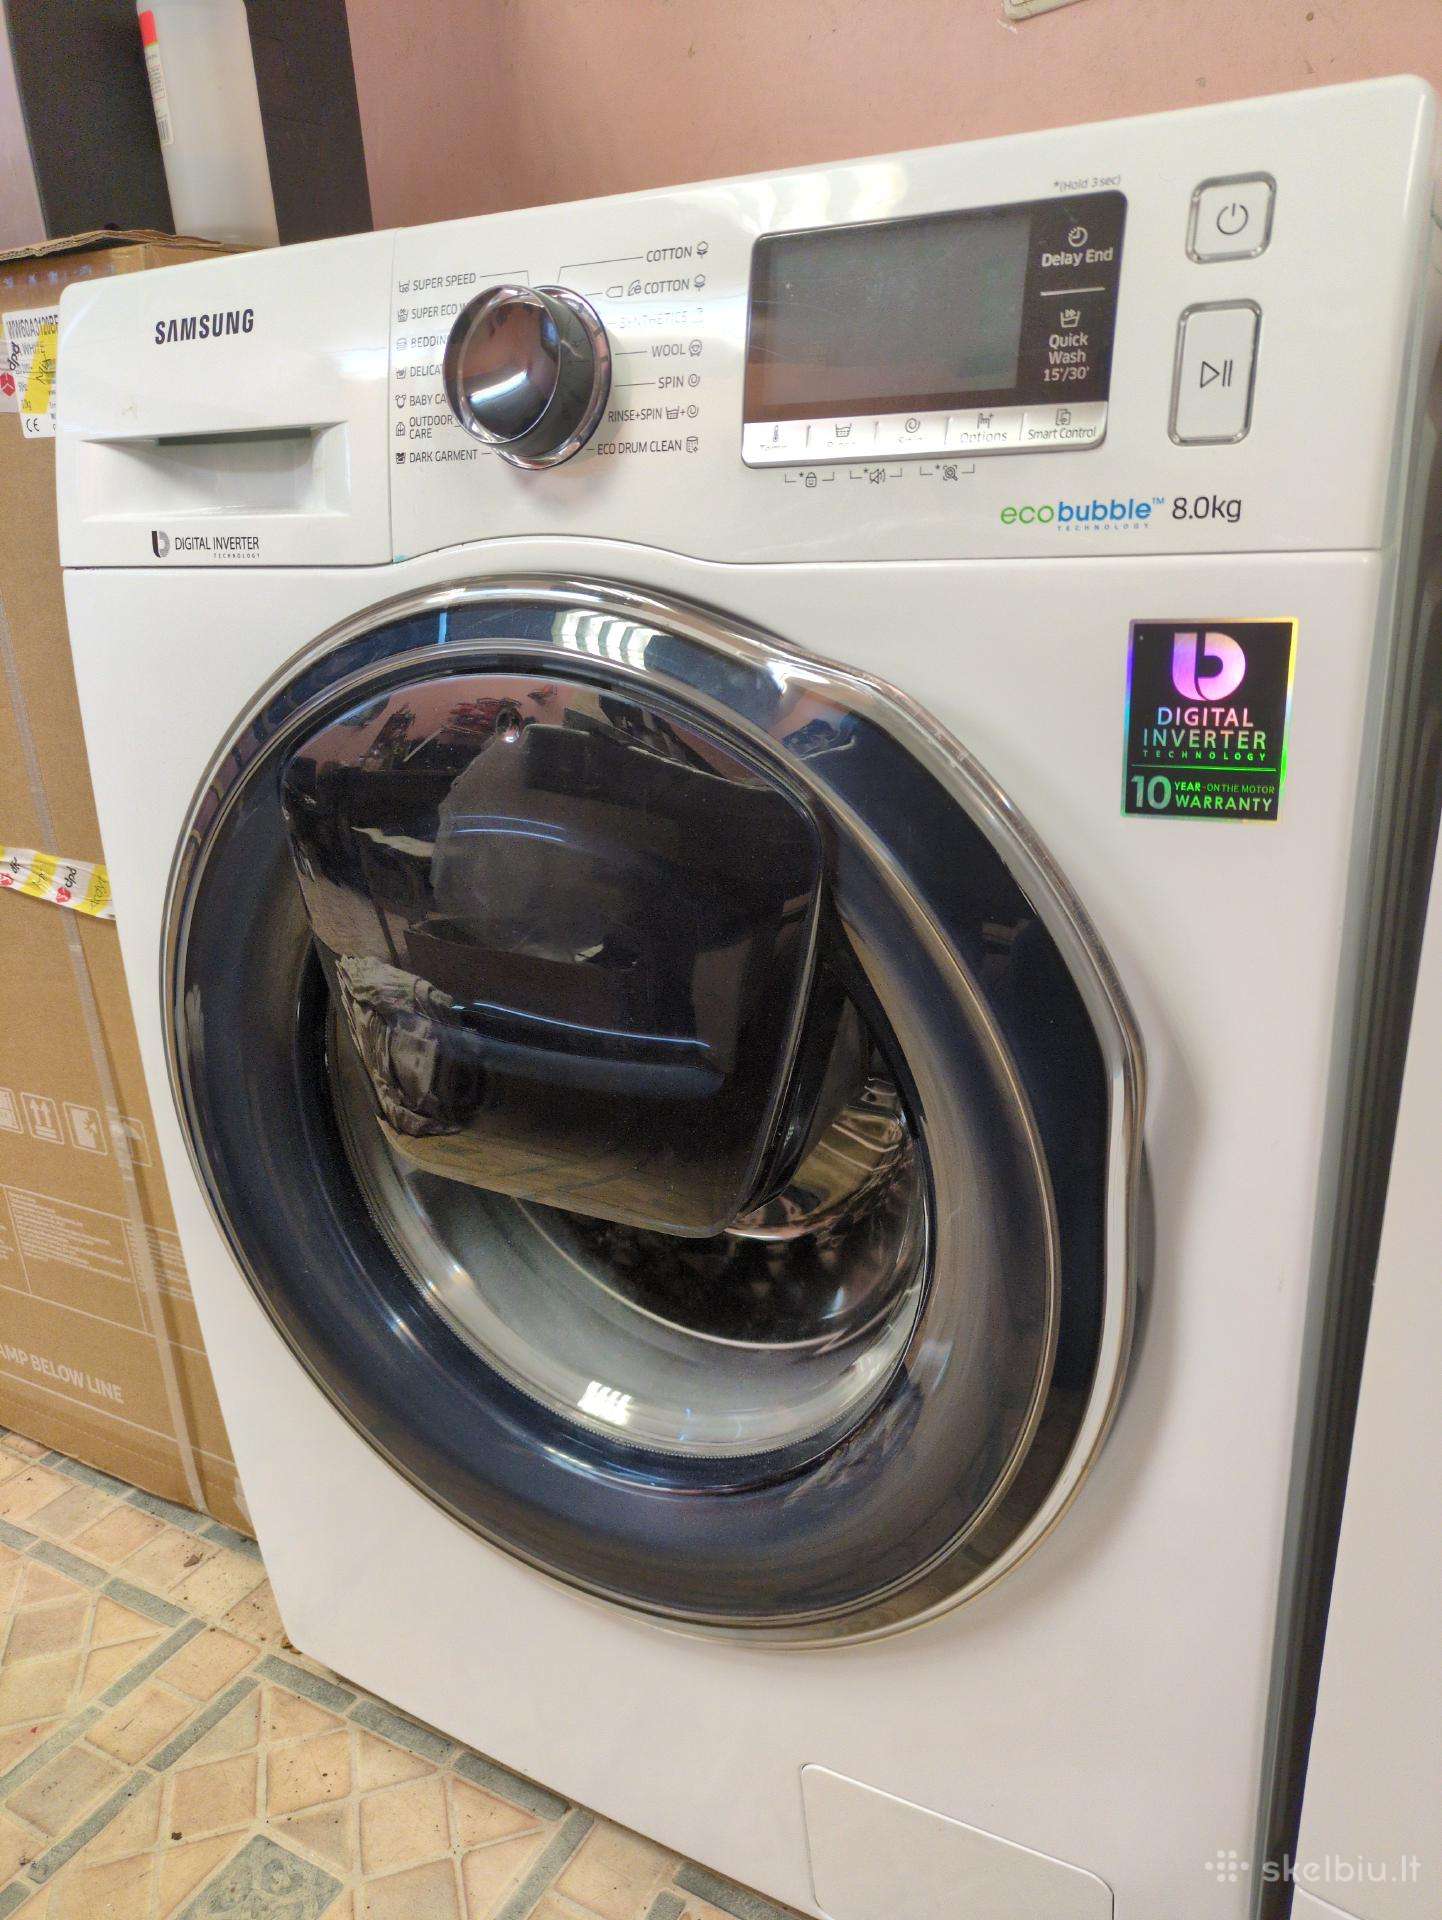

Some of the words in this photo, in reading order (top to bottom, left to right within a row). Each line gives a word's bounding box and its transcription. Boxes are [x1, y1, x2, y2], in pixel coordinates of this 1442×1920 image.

[1090, 177, 1099, 188] 3
[646, 246, 693, 263] COTTON
[1041, 251, 1083, 267] Delay
[1084, 247, 1114, 263] End
[413, 276, 443, 291] SUPER
[445, 272, 477, 287] SPEED
[644, 279, 690, 295] COTTON
[411, 306, 439, 320] SUPER
[440, 304, 458, 316] ECO
[155, 308, 254, 345] SAMSUNG
[411, 335, 447, 348] BEDDIN
[1048, 331, 1089, 350] Quick
[651, 343, 687, 358] WOOL
[1048, 349, 1087, 365] Wash
[410, 363, 443, 377] DELICA
[1043, 366, 1090, 382] 15'/30'
[658, 375, 685, 390] SPIN
[410, 394, 433, 407] BABY
[434, 393, 448, 405] CA
[409, 414, 454, 428] OUTDOOR
[608, 407, 664, 423] RINSE+SPIN
[409, 428, 433, 440] CARE
[960, 430, 1008, 444] Options
[1028, 428, 1057, 441] Smart
[1059, 426, 1097, 440] Control
[597, 443, 616, 456] ECO
[618, 441, 647, 454] DRUM
[649, 439, 682, 453] CLEAN
[409, 451, 433, 463] DARK
[435, 449, 478, 462] GARMENT
[1172, 495, 1242, 523] 8.0kg
[1057, 522, 1150, 532] TECHNOLOGY
[175, 536, 211, 550] DIGITAL
[213, 536, 260, 550] INVERTER
[1157, 706, 1254, 729] DIGITAL
[1143, 727, 1267, 750] INVERTER
[1143, 750, 1267, 762] TECHNOLOGY
[1131, 774, 1172, 811] 10
[1174, 781, 1201, 793] YEAR
[1221, 783, 1240, 794] THE
[1241, 784, 1275, 795] MOTOR
[1175, 794, 1273, 812] WARRANTY
[65, 866, 77, 888] dpd
[30, 1353, 84, 1389] BELOW
[86, 1374, 124, 1404] LINE
